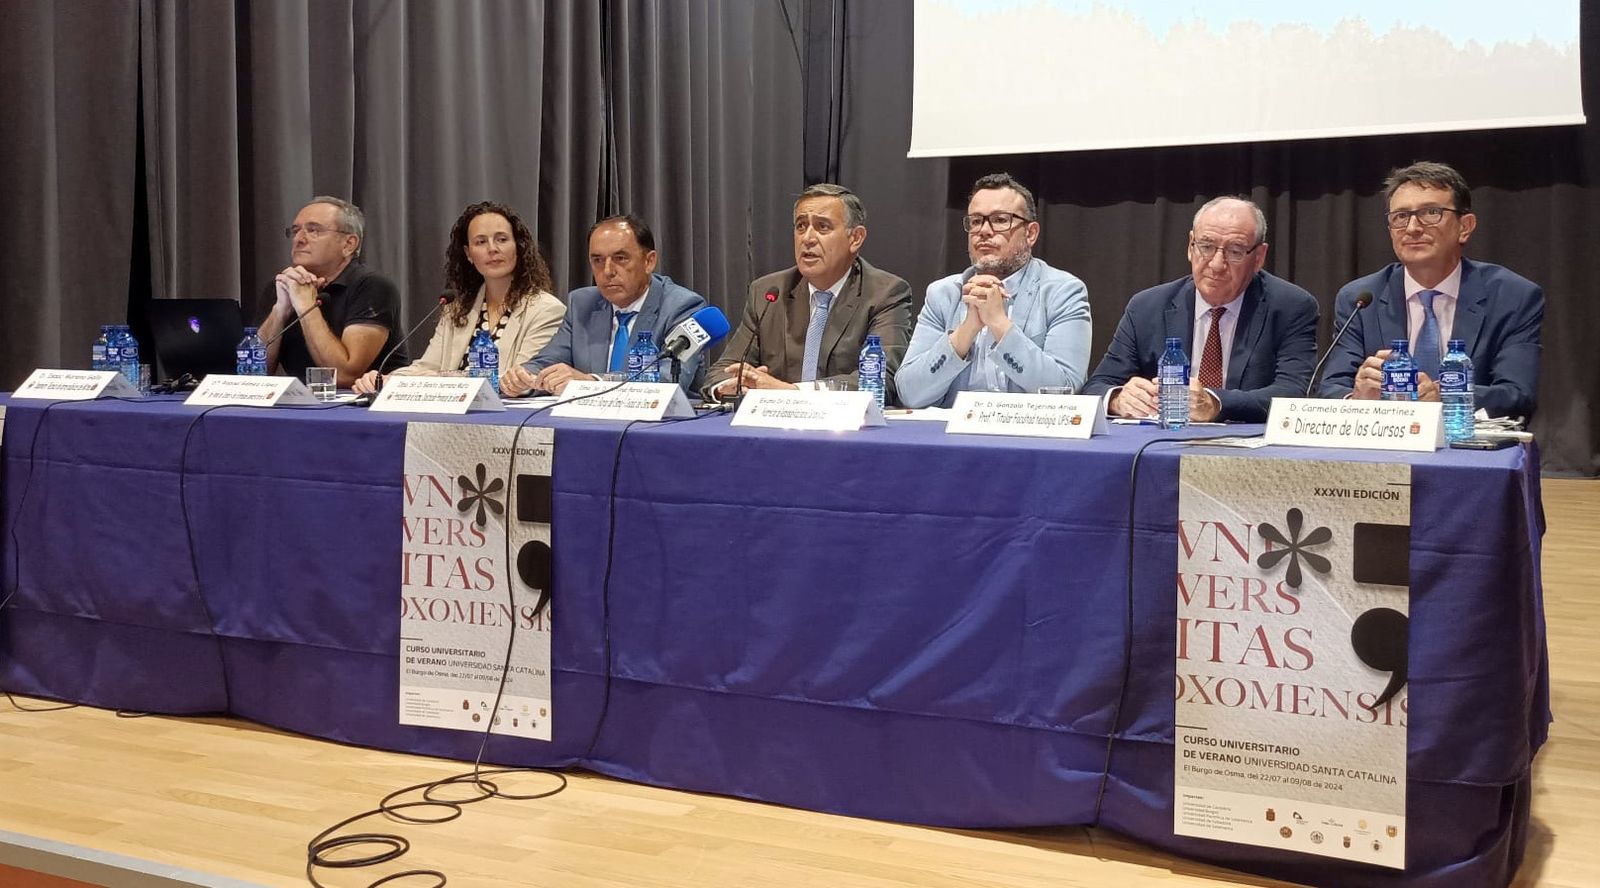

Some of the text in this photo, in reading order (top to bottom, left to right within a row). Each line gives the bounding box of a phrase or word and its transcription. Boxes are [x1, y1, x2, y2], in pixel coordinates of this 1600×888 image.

[996, 401, 1024, 409] Gonzalo
[1289, 403, 1416, 416] D. Carmelo Gómez Martínez
[1294, 417, 1405, 438] Director de los Cursos
[516, 447, 546, 457] EDICIÓN
[1313, 487, 1400, 501] XXXVII EDICIÓN
[403, 517, 486, 548] VERS
[402, 552, 495, 591] ITAS
[1177, 572, 1301, 616] VERS
[406, 645, 486, 658] CURSO UNIVERSITARIO
[1176, 617, 1314, 672] ITAS
[405, 656, 415, 664] DE
[416, 657, 447, 666] VERANO
[448, 660, 492, 671] UNIVERSIDAD
[515, 666, 546, 676] CATALINA
[1183, 735, 1300, 756] CURSO UNIVERSITARIO
[1183, 749, 1397, 785] DE VERANO UNIVERSIDAD SANTA CATALINA
[1191, 766, 1213, 775] Burgo
[1214, 768, 1224, 776] de
[1247, 772, 1259, 780] del
[1260, 773, 1281, 783] 22/07
[1290, 777, 1312, 787] 09/08
[1313, 780, 1322, 788] de
[1324, 782, 1343, 791] 2024
